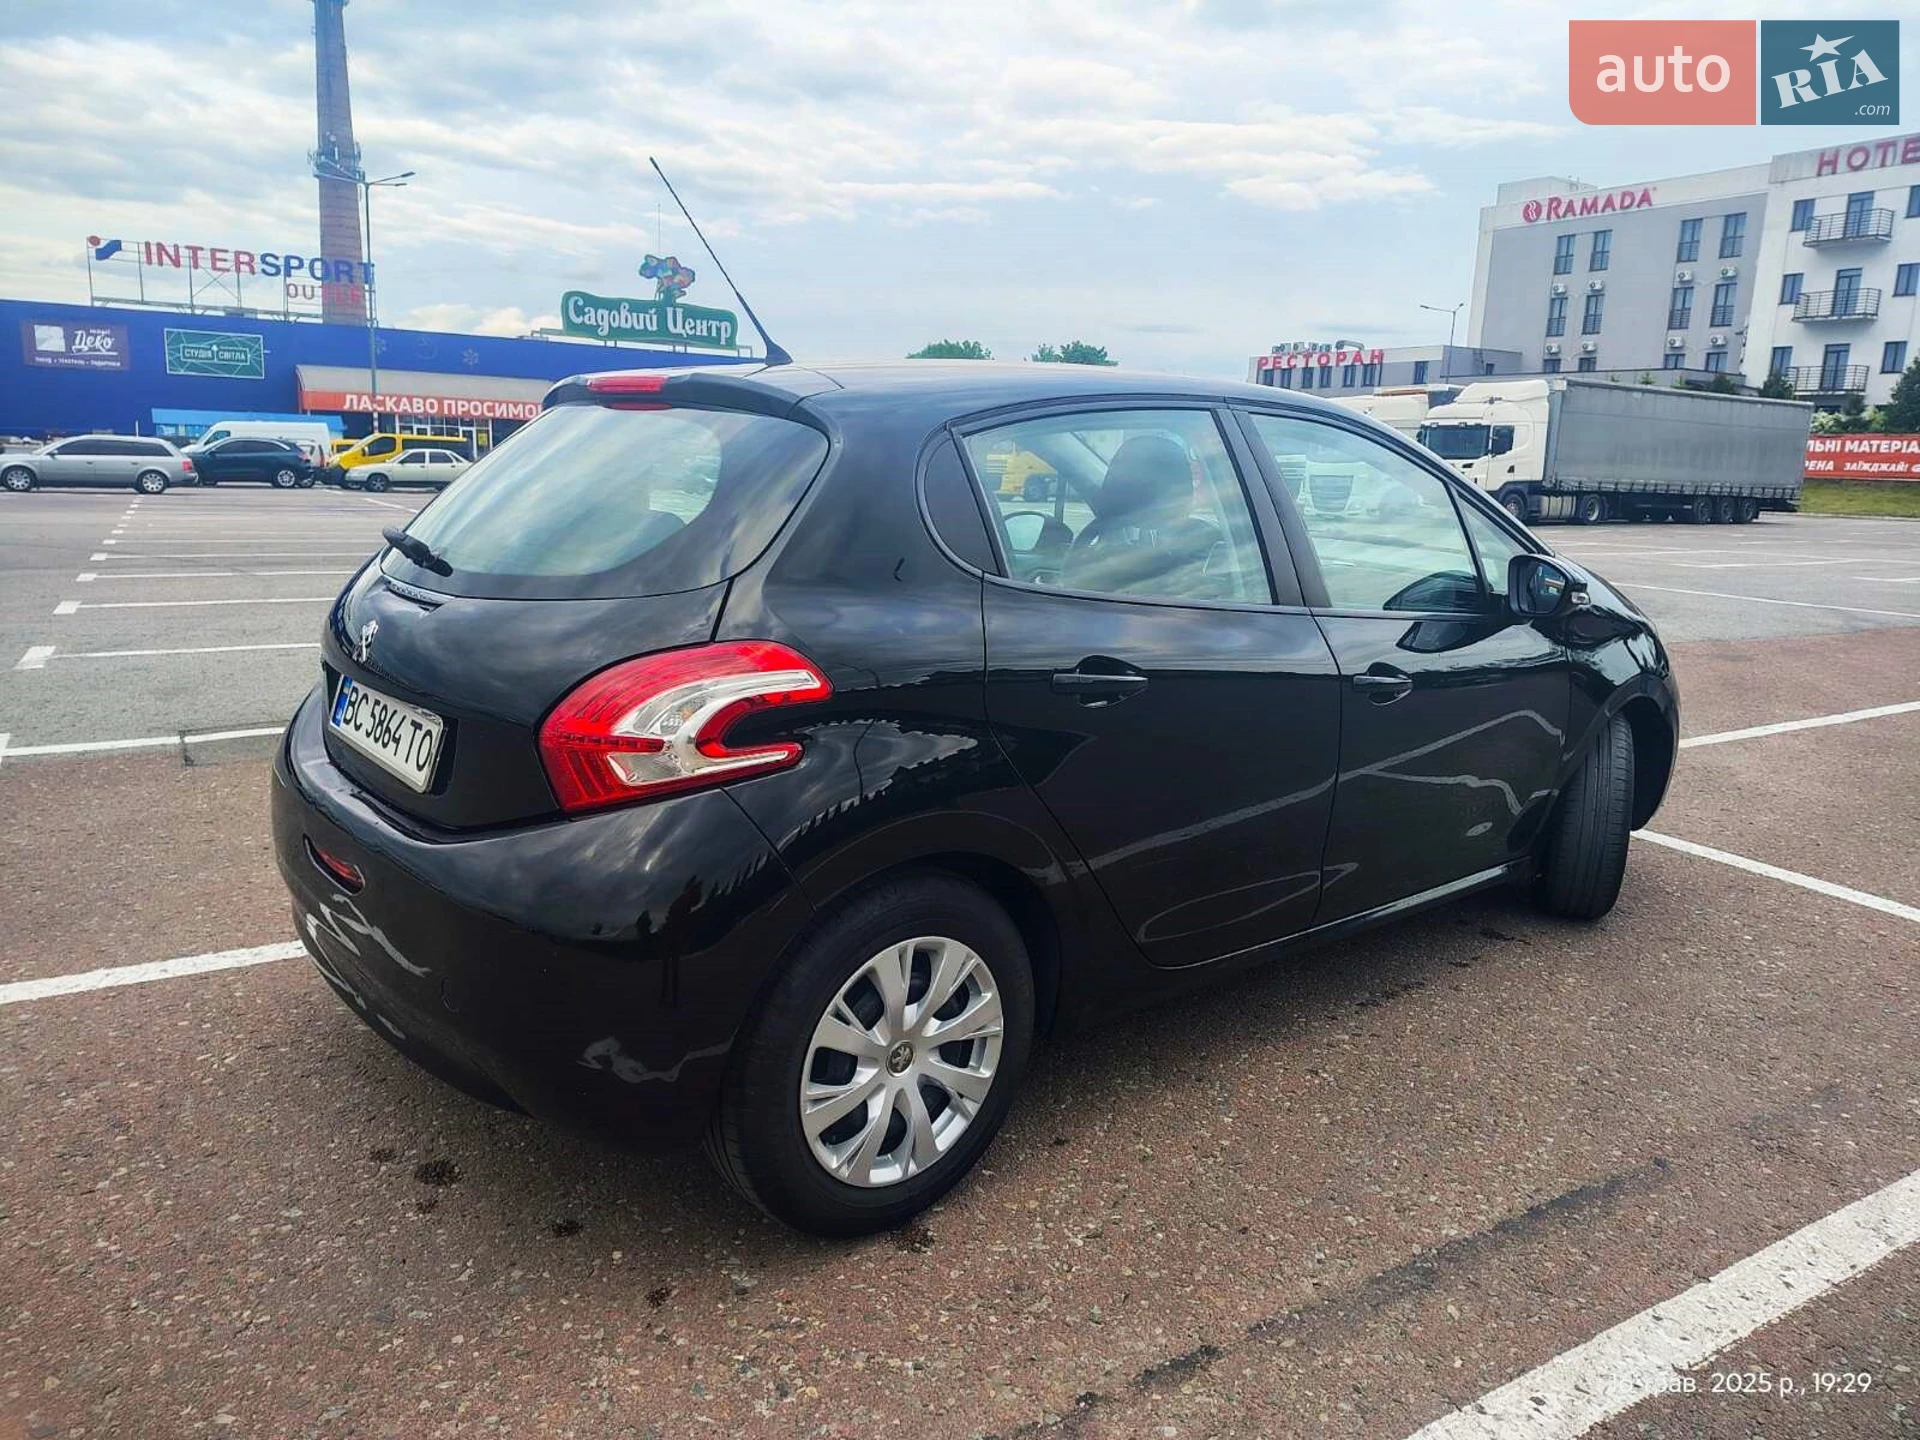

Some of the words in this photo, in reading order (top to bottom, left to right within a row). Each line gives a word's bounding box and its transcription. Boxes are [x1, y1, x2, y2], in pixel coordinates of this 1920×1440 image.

[1816, 135, 1920, 177] HOTE
[1546, 188, 1653, 221] RAMADA
[144, 241, 375, 285] INTERSPORT
[567, 296, 658, 336] Садовий
[666, 306, 732, 346] Центр
[1257, 348, 1384, 370] РЕСТОРАН
[343, 686, 369, 732] BC
[365, 698, 407, 757] 5864
[405, 719, 433, 772] TO
